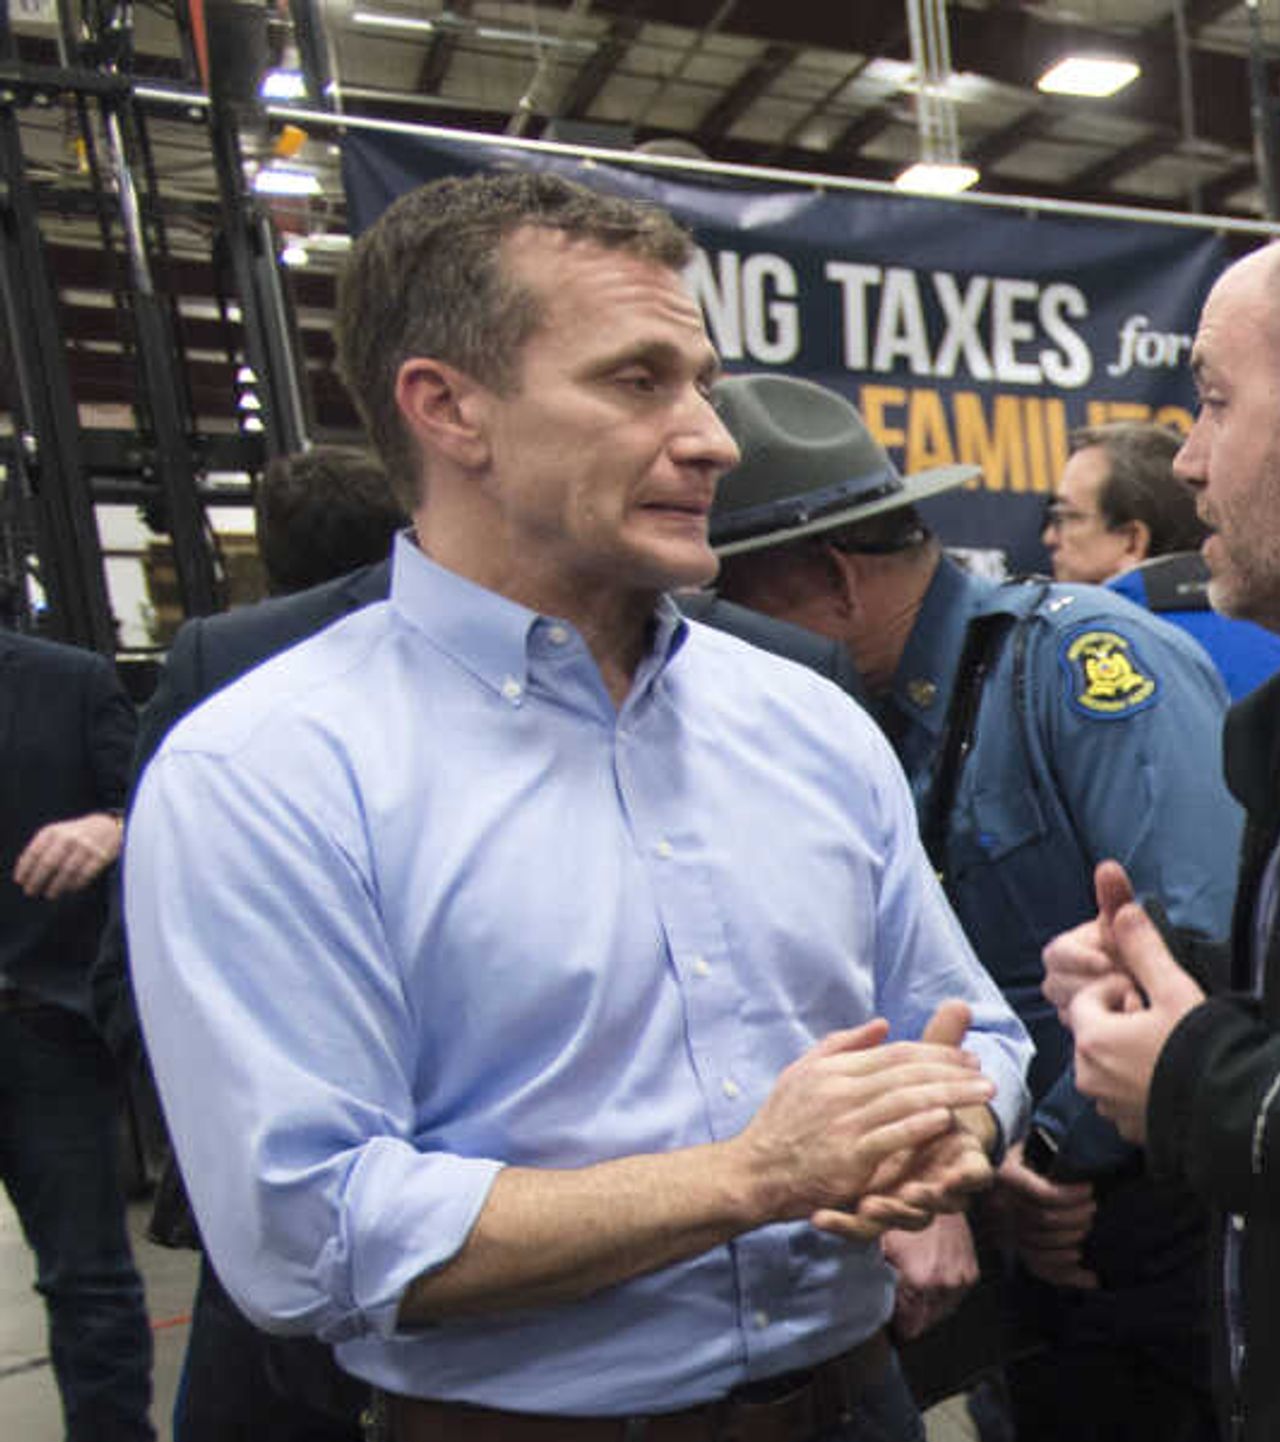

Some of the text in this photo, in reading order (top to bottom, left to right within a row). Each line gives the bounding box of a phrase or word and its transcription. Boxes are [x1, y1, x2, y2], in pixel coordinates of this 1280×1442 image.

[826, 261, 1093, 388] TAXES
[1108, 316, 1194, 377] for
[860, 385, 1196, 493] FAMIL
